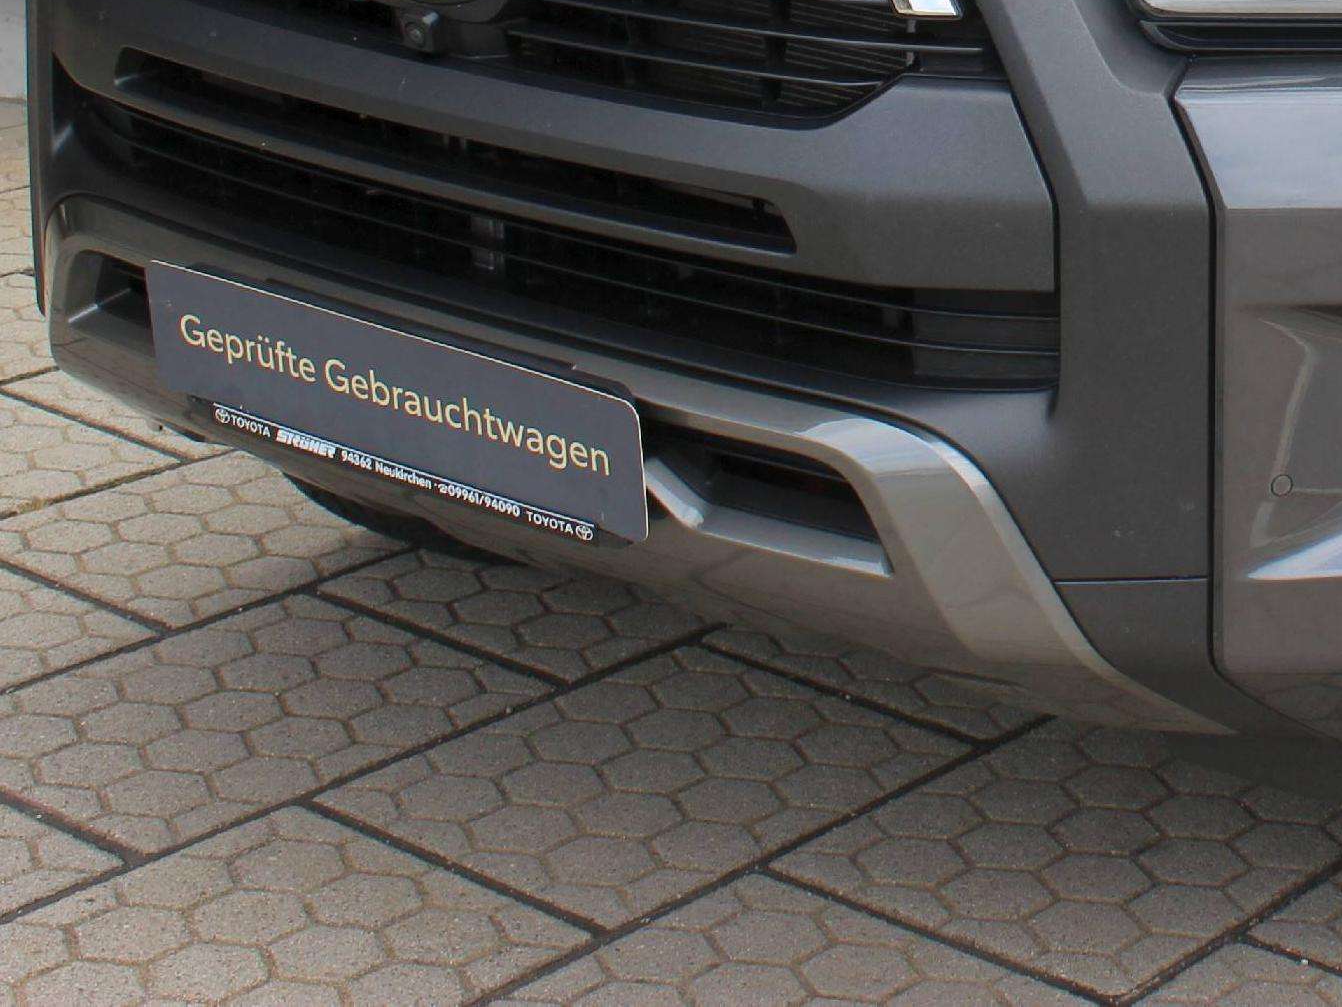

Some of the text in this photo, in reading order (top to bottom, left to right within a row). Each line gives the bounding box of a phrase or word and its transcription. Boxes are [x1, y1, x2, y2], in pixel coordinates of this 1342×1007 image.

[180, 313, 609, 475] Geprüfte Gebrauchtwagen
[231, 414, 271, 438] TOYOTA
[375, 461, 432, 490] Neukirchen
[525, 510, 574, 535] TOYOTA
